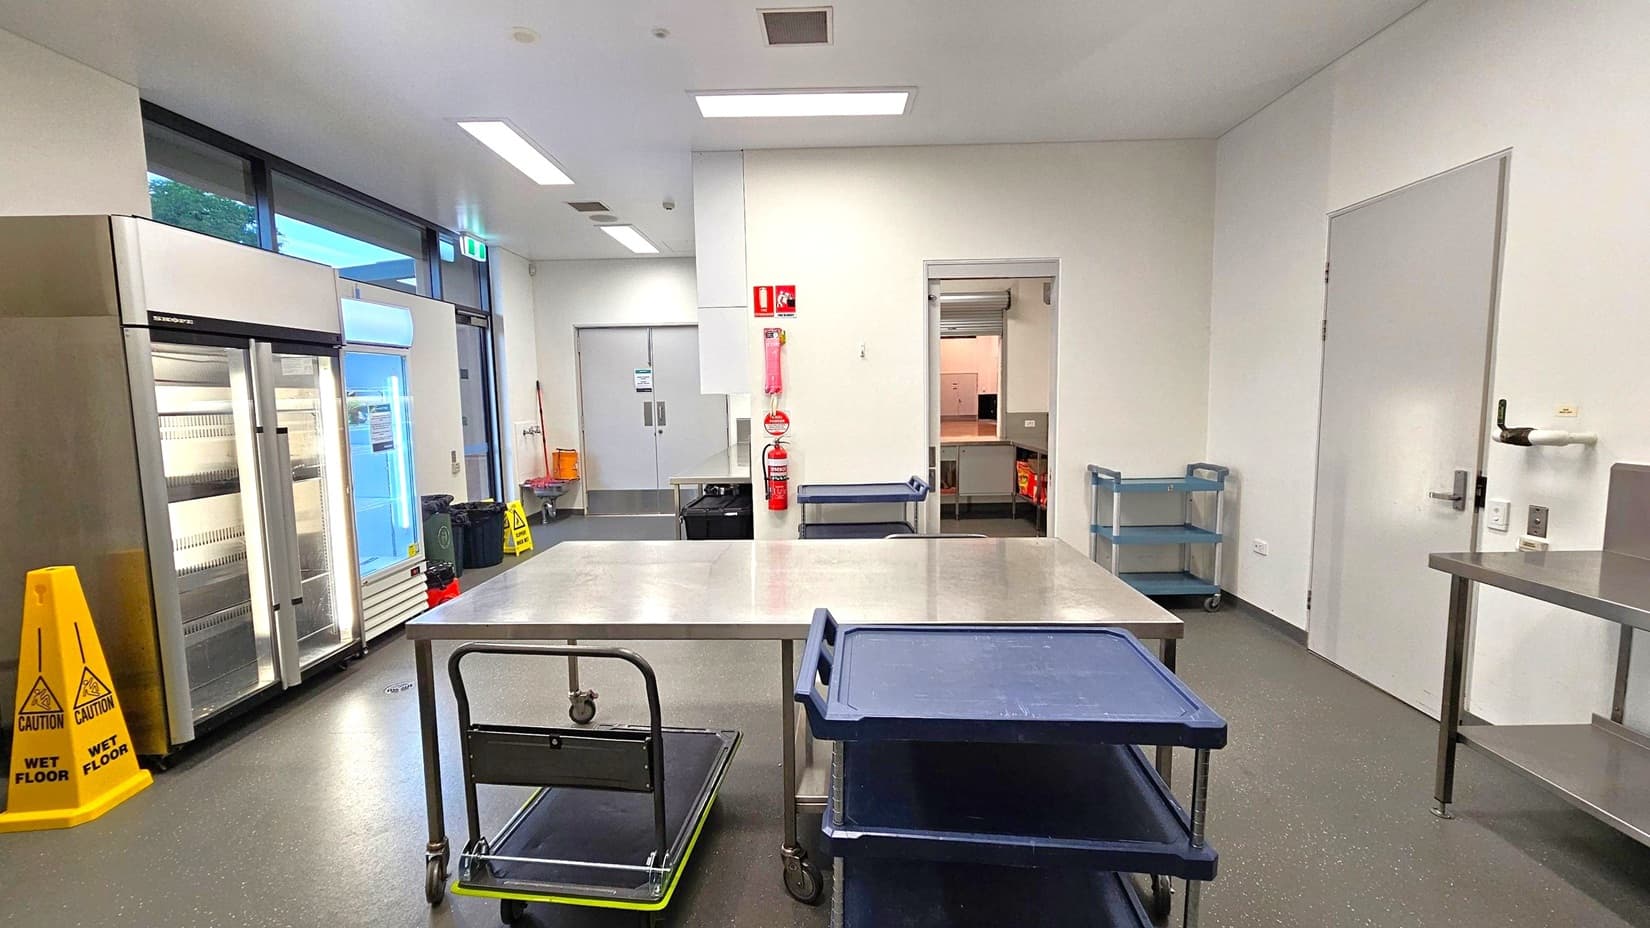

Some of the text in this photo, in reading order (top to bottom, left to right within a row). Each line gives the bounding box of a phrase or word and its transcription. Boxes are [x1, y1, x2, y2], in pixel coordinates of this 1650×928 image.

[152, 315, 194, 325] SKOPE
[74, 695, 115, 725] CAUTION
[18, 714, 65, 732] CAUTION
[88, 734, 118, 758] WET
[24, 756, 59, 769] WET
[82, 743, 129, 775] FLOOR
[15, 770, 69, 784] FLOOR
